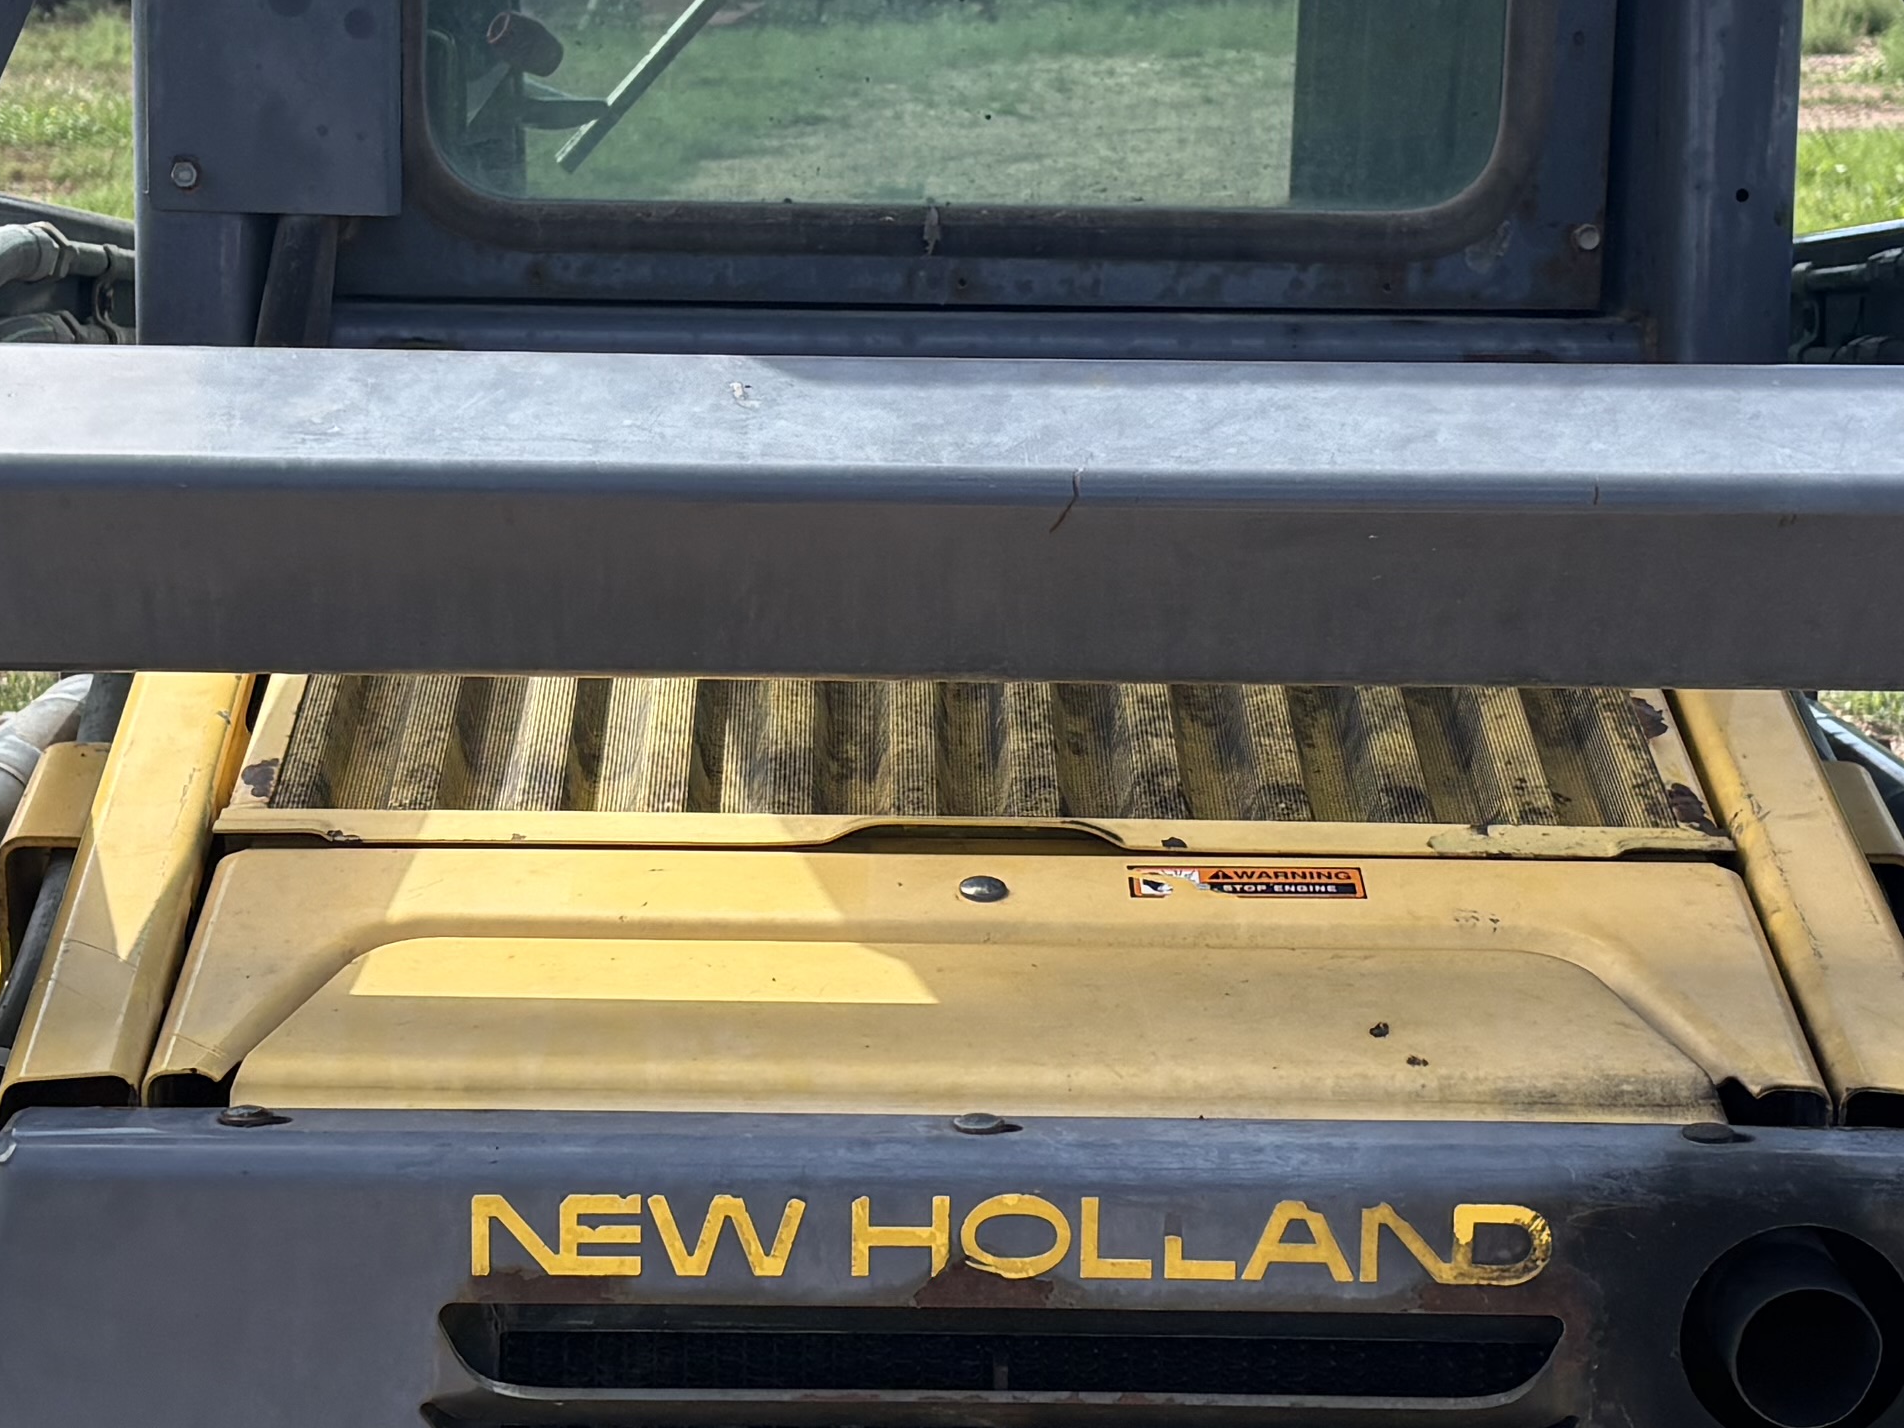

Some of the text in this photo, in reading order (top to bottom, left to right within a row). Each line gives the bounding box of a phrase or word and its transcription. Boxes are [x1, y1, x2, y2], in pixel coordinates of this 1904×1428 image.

[1234, 870, 1351, 880] WARNING
[1223, 884, 1337, 892] STOP ENGINE
[472, 1194, 1554, 1285] NEW HOLLAND
